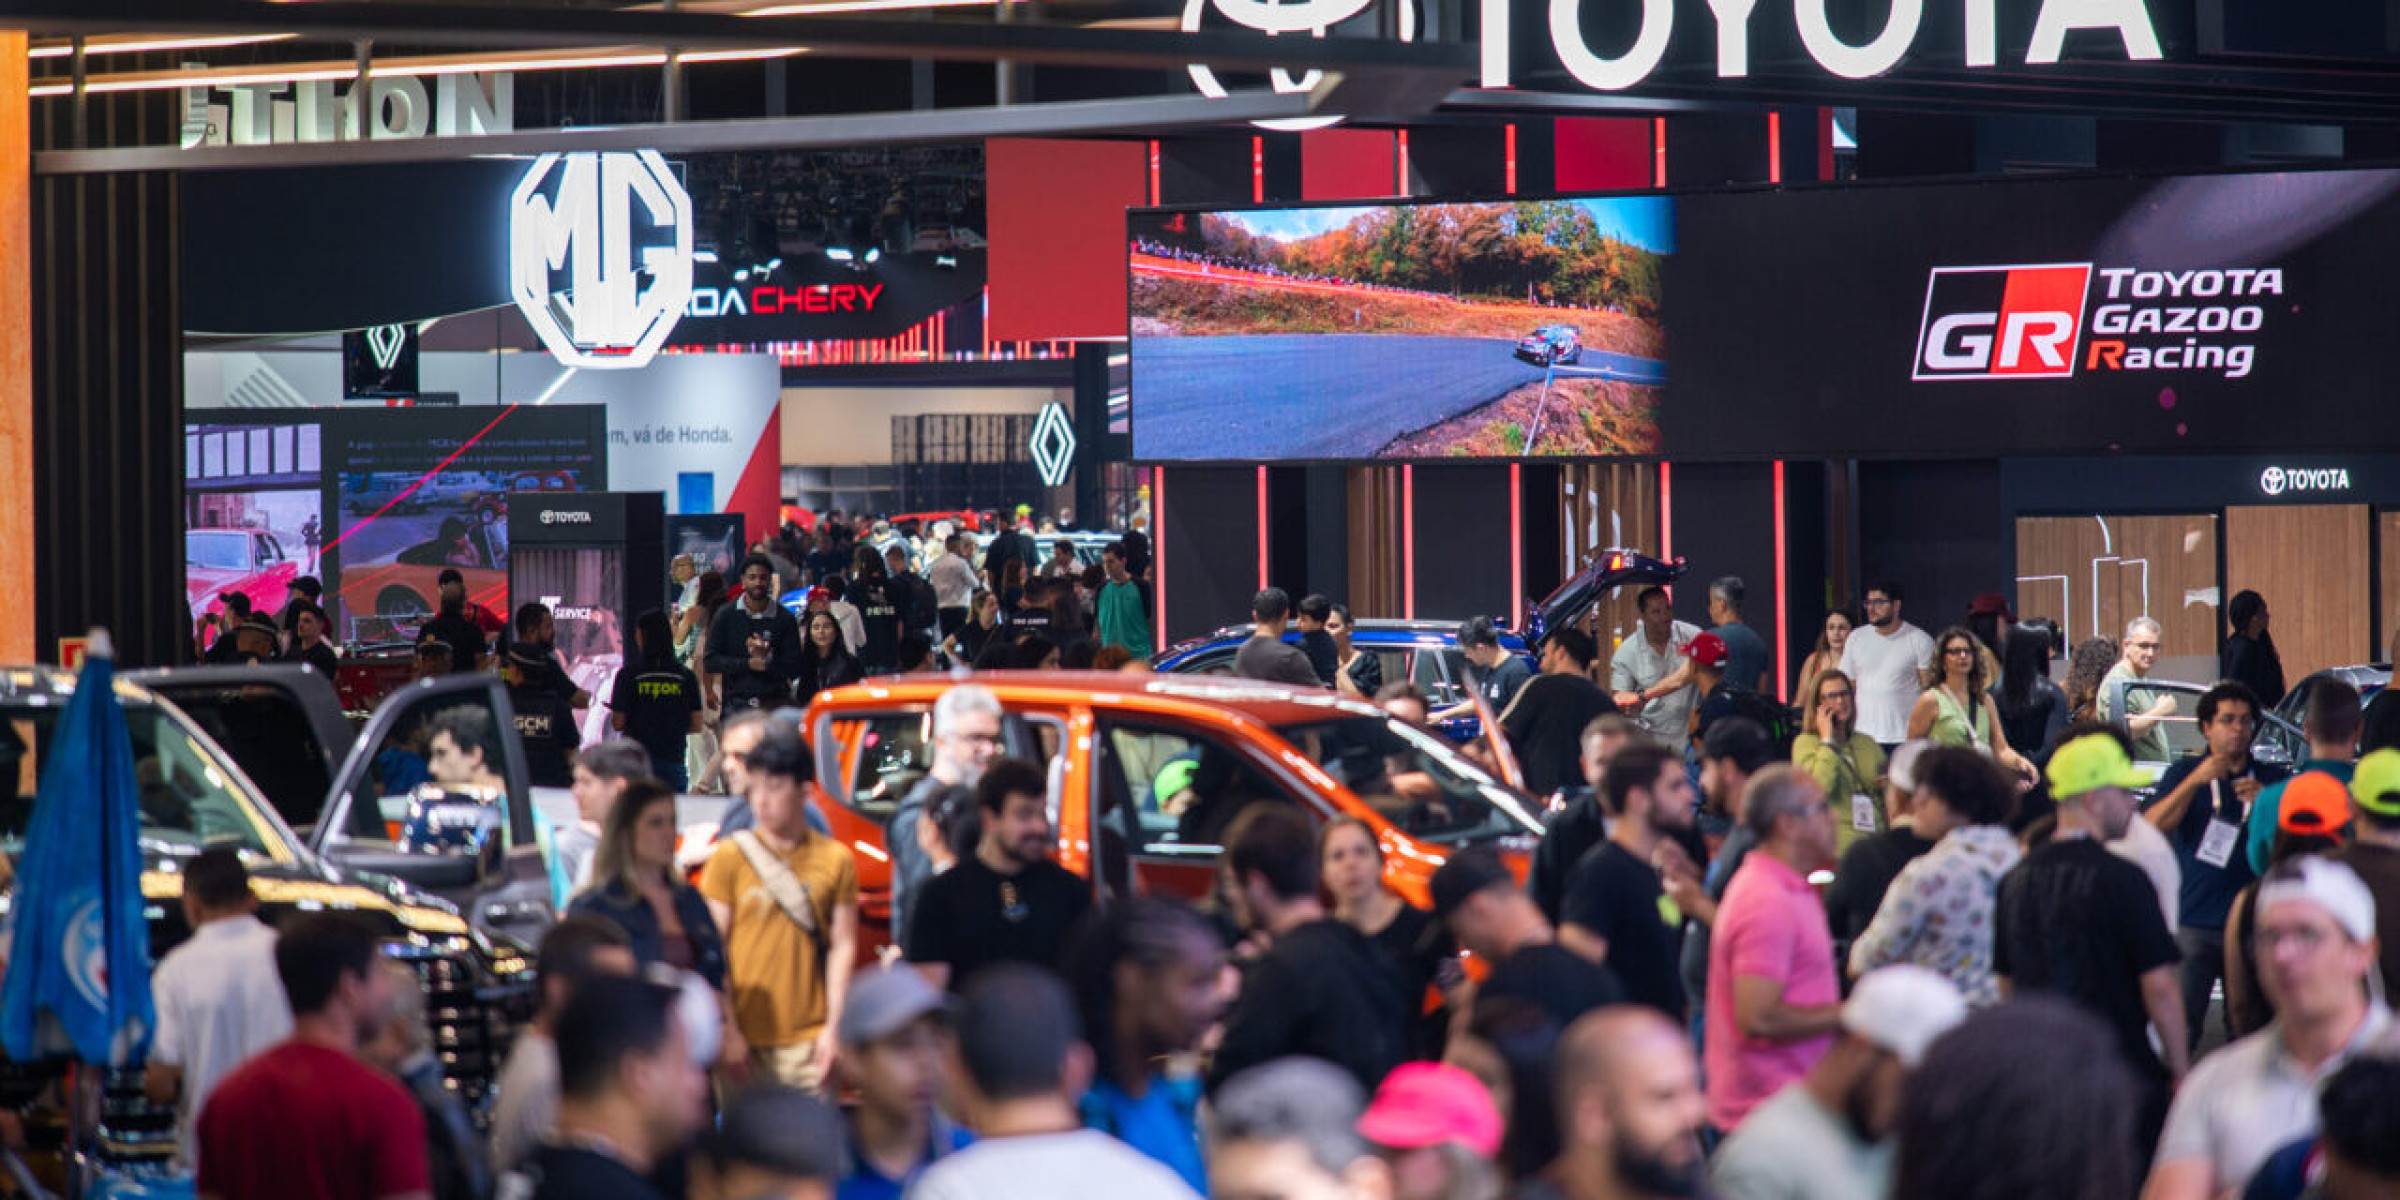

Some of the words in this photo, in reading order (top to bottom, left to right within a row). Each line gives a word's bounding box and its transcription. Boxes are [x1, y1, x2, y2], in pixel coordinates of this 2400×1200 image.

[520, 151, 684, 352] MG
[2099, 267, 2283, 298] TOYOTA
[751, 283, 884, 314] CHERY
[2092, 305, 2264, 334] GAZOO
[1924, 311, 2075, 370] GR
[2086, 339, 2256, 378] Racing
[633, 424, 651, 443] vá
[655, 425, 674, 443] de
[679, 425, 732, 443] Honda.
[2286, 468, 2350, 491] TOYOTA
[555, 511, 592, 523] TOYOTA
[554, 607, 592, 620] SERVICE
